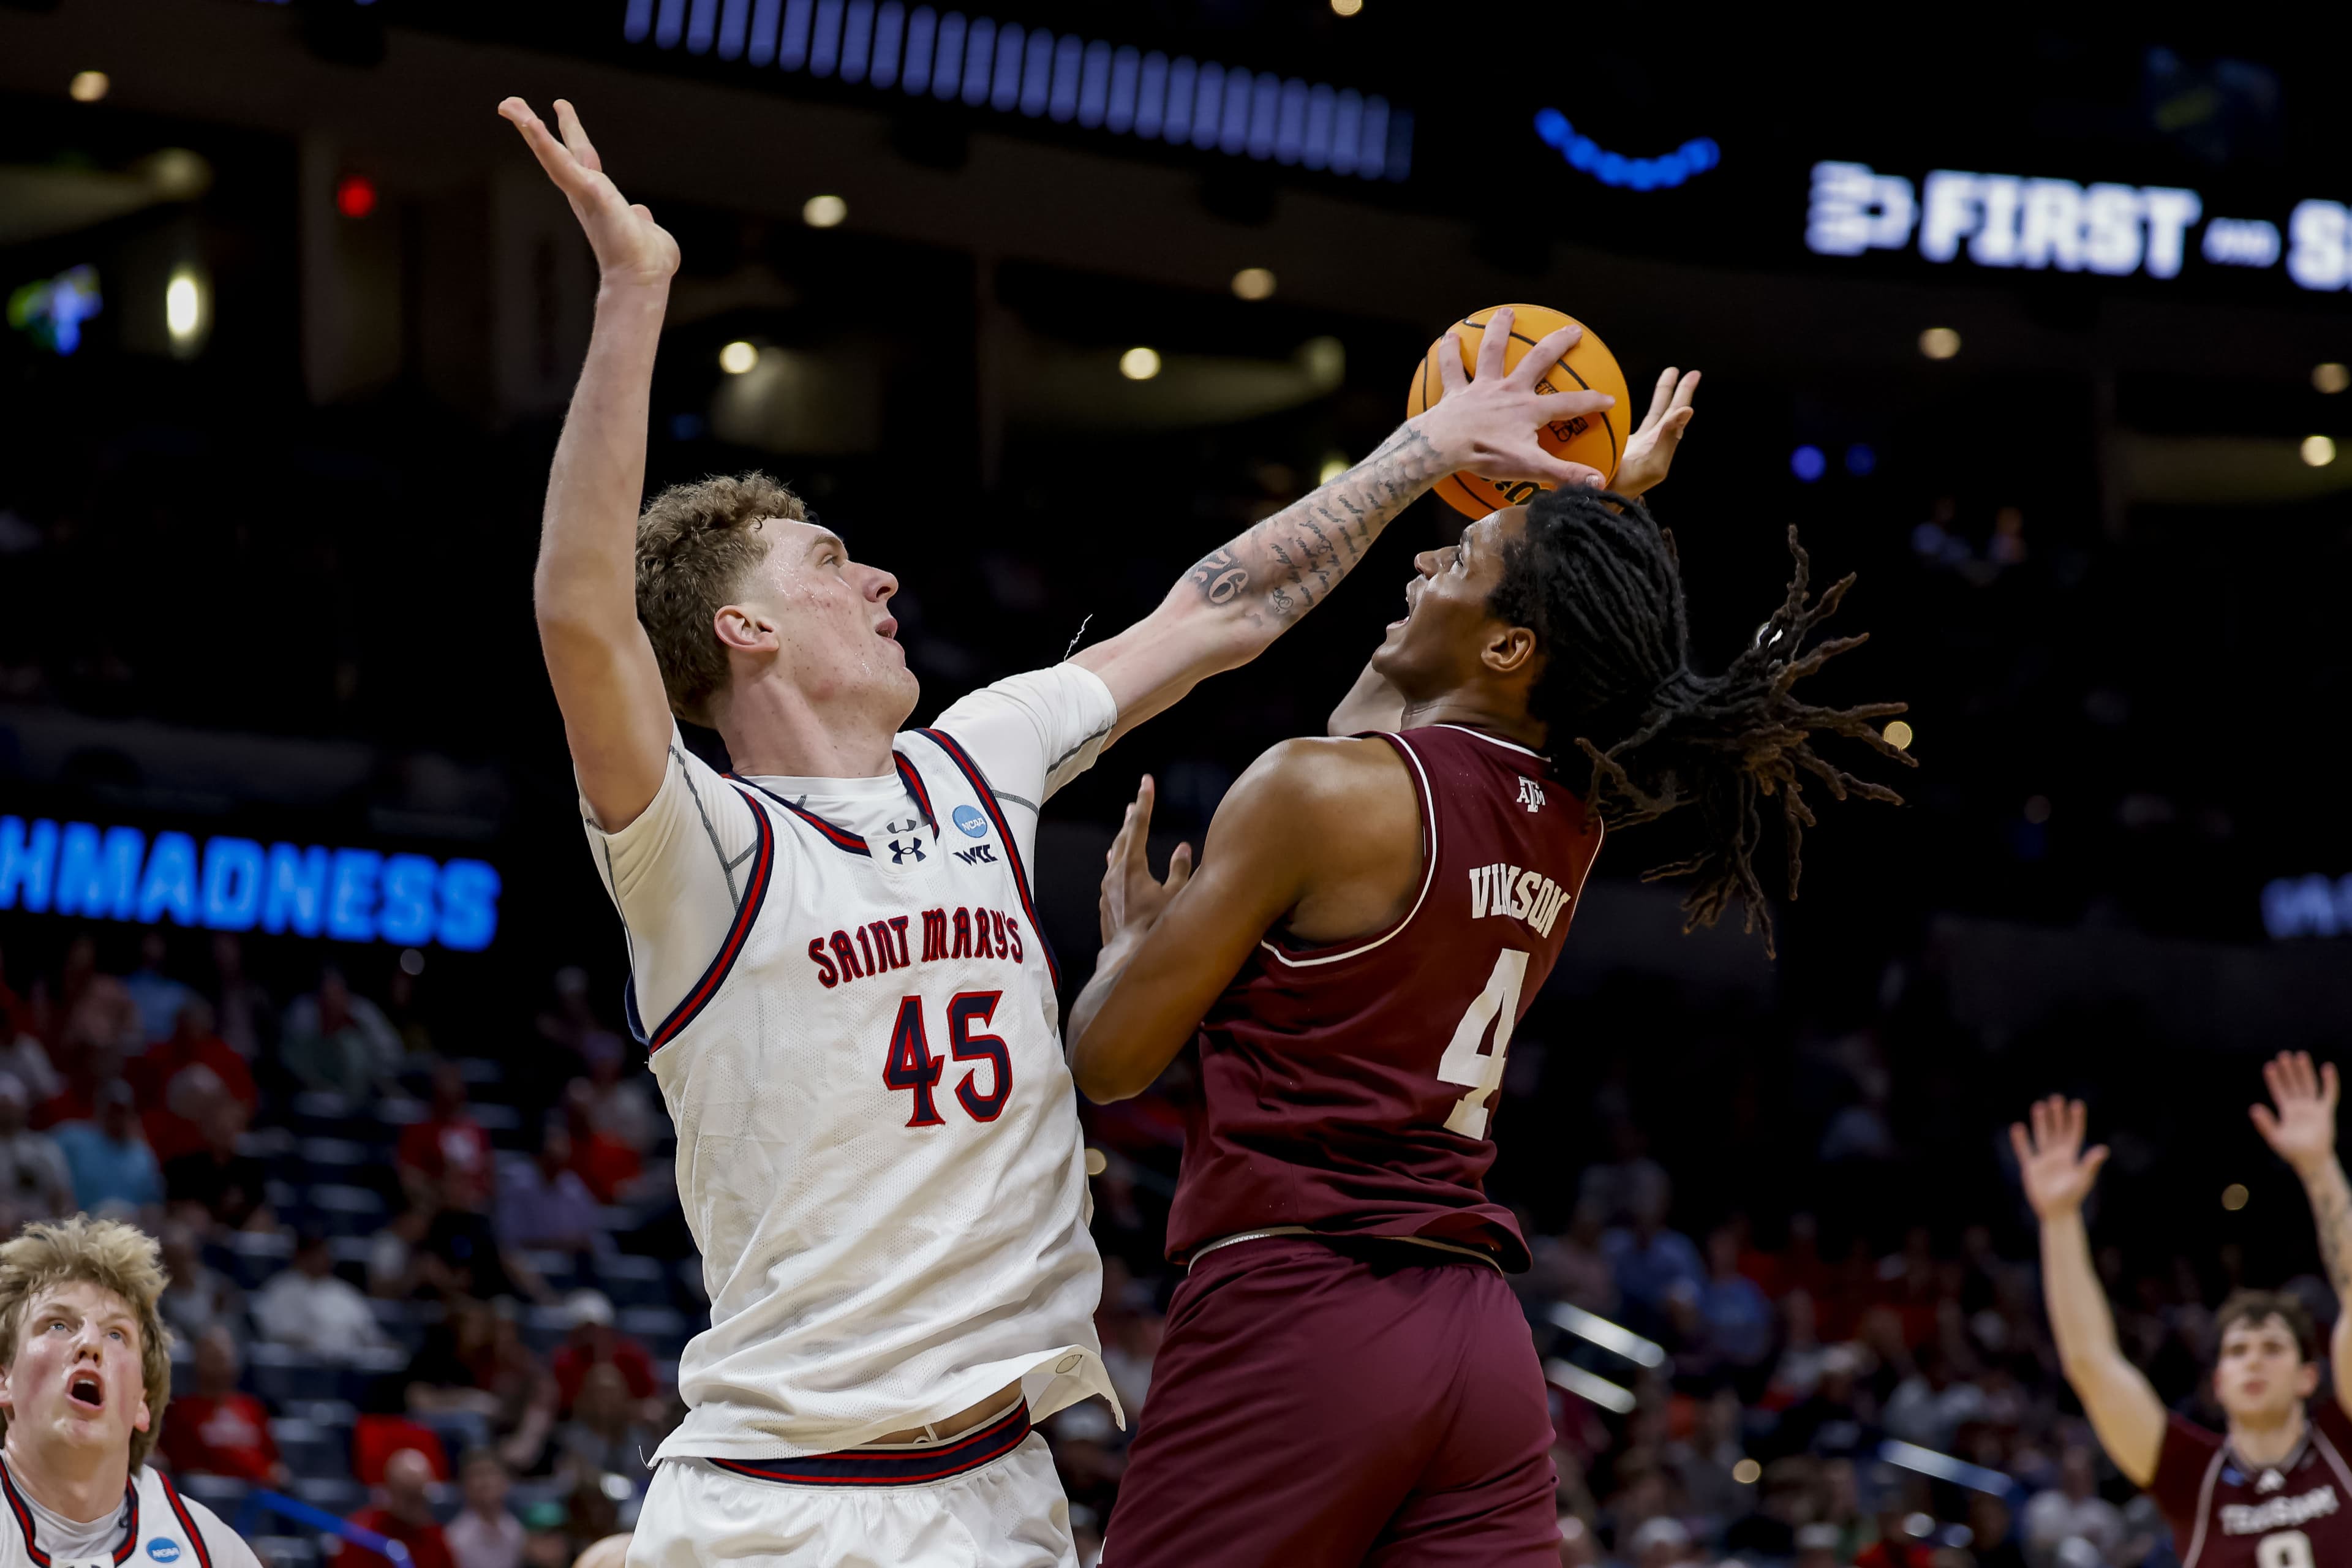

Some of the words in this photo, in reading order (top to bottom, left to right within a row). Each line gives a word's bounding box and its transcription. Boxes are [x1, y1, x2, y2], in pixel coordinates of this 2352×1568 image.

[1921, 171, 2201, 279] FIRST
[952, 844, 998, 867] WCC
[961, 818, 986, 831] NCAA
[808, 915, 911, 989] SAINT
[921, 907, 1024, 964] MARY'S
[882, 990, 1014, 1128] 45
[1436, 948, 1530, 1141] 4
